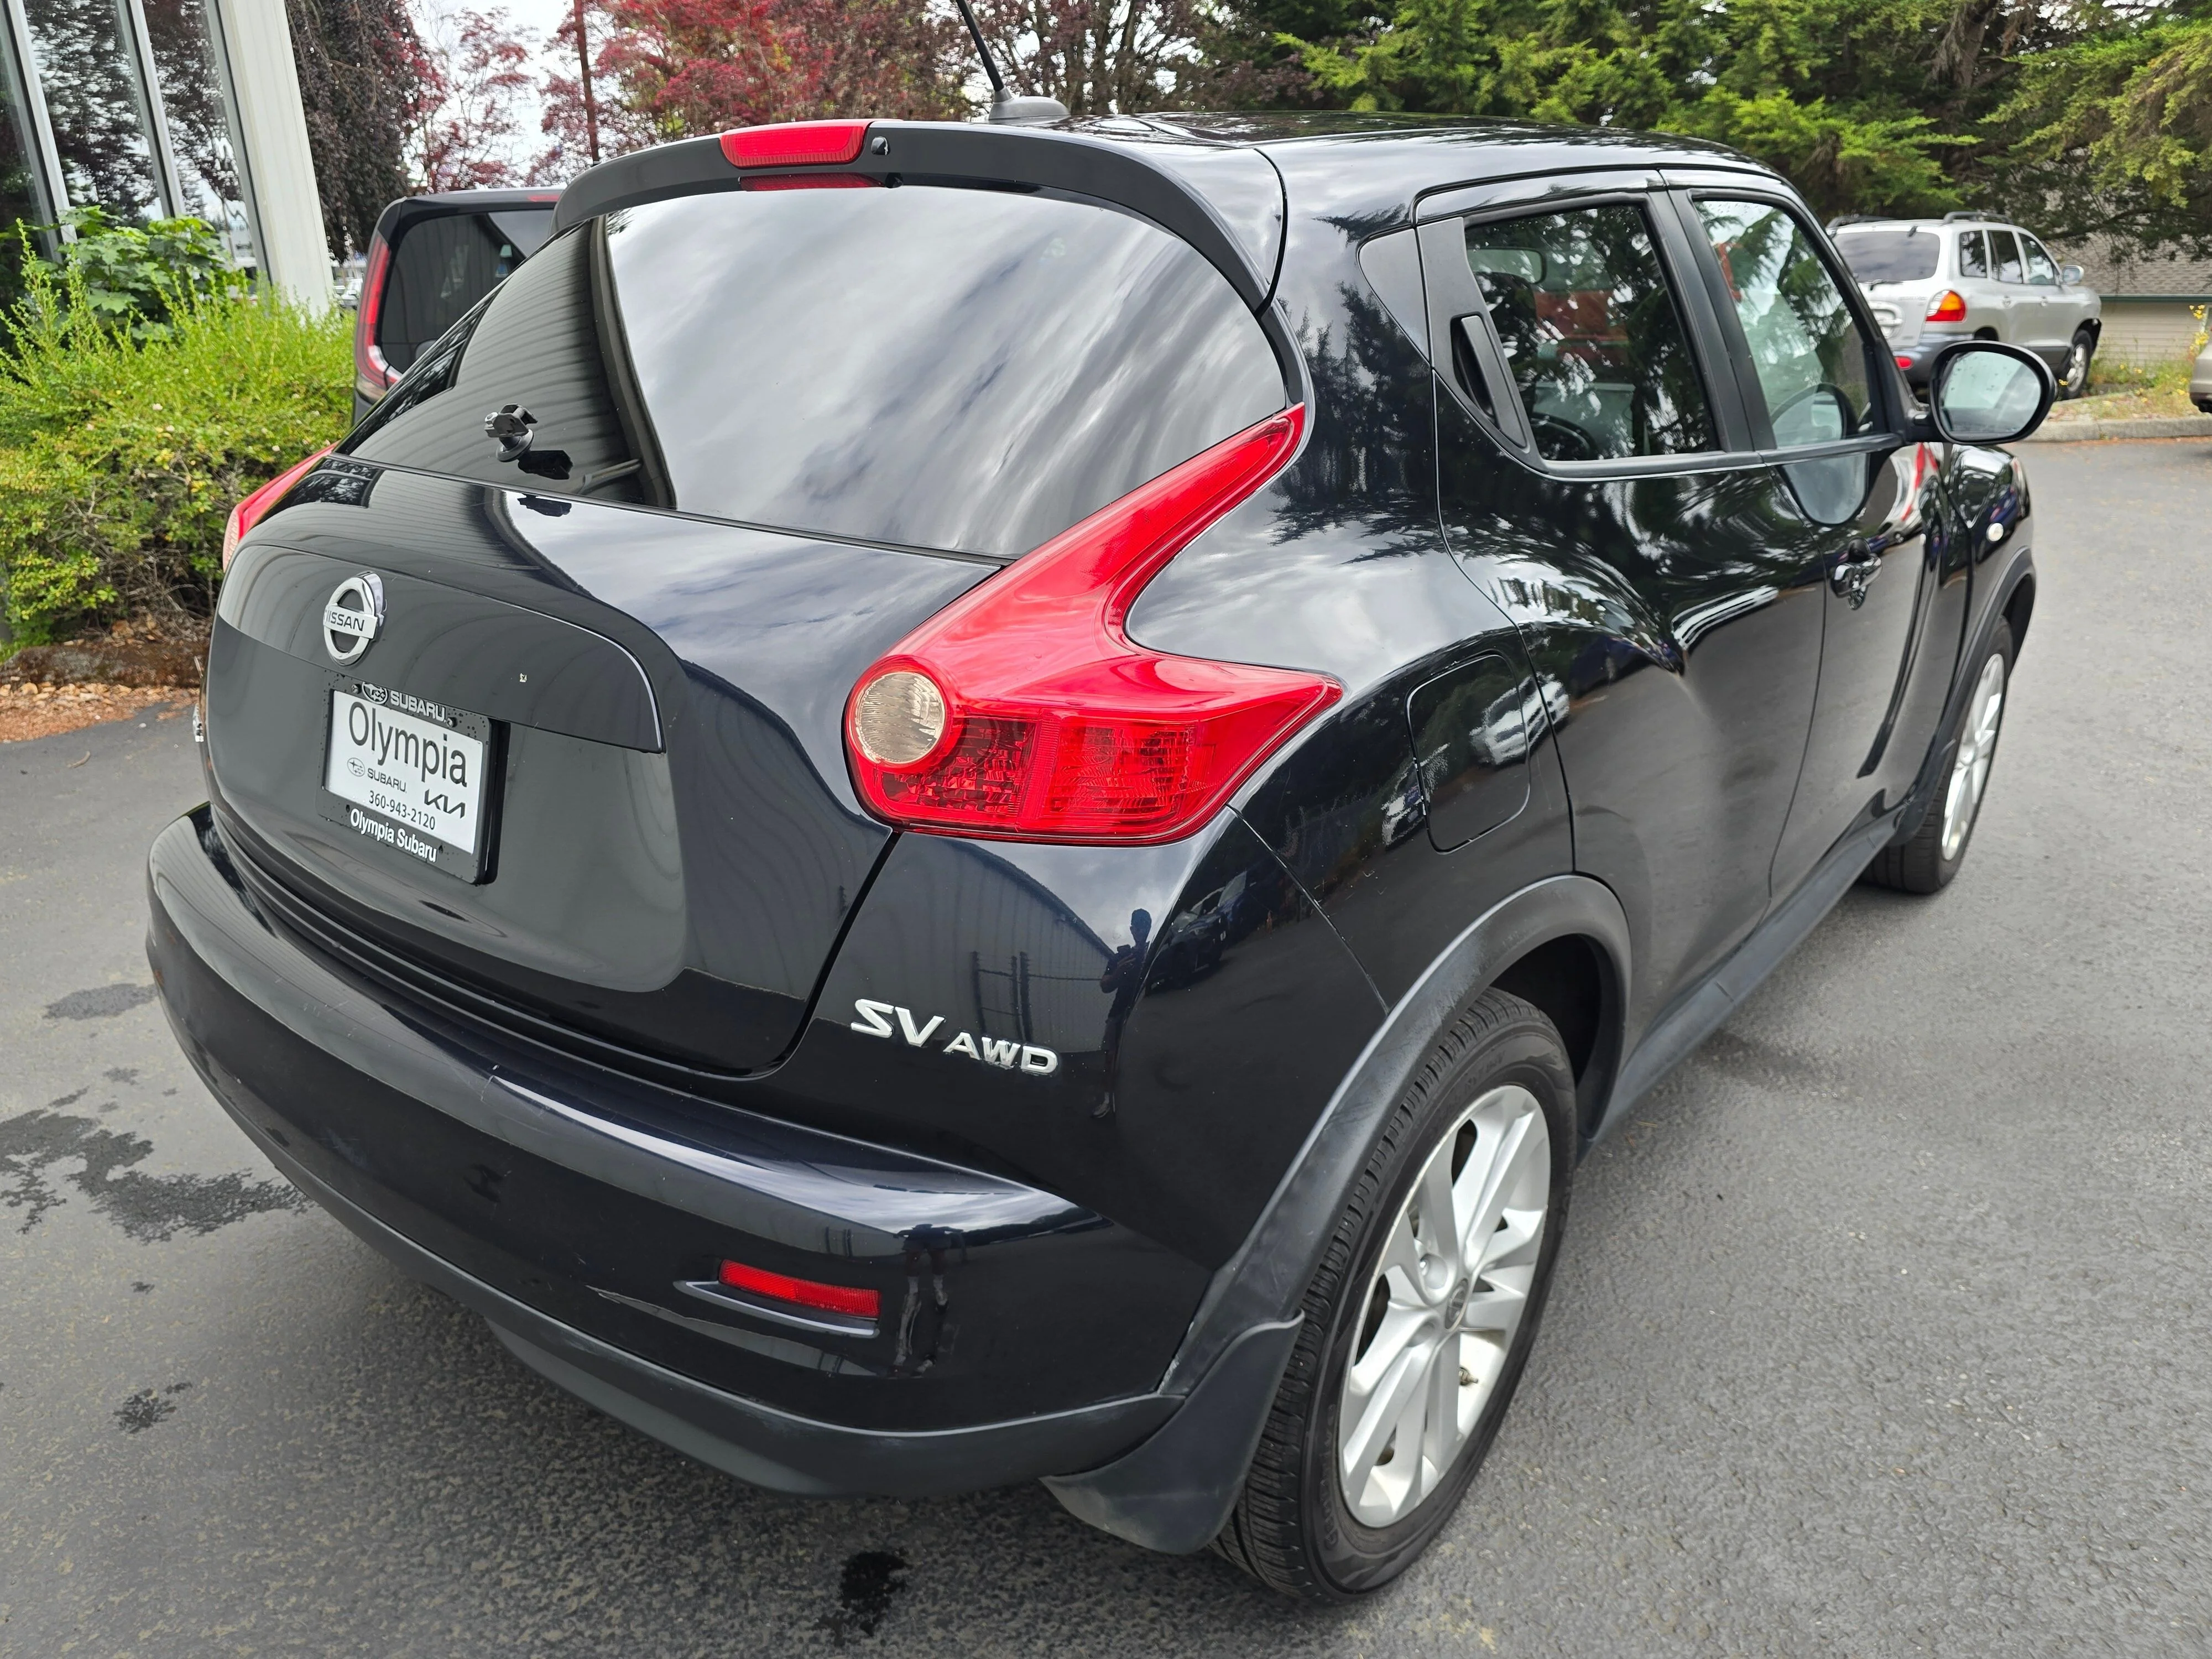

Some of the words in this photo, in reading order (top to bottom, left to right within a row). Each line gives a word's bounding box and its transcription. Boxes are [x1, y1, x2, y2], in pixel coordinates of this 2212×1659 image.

[390, 690, 445, 722] SUBARU
[348, 702, 467, 787] Olympia
[367, 768, 406, 792] SUBARU
[368, 790, 435, 830] 360-943-2120
[350, 808, 395, 841] Olympia
[397, 828, 437, 862] Subaru
[851, 999, 946, 1047] SV
[942, 1032, 1058, 1074] AWD
